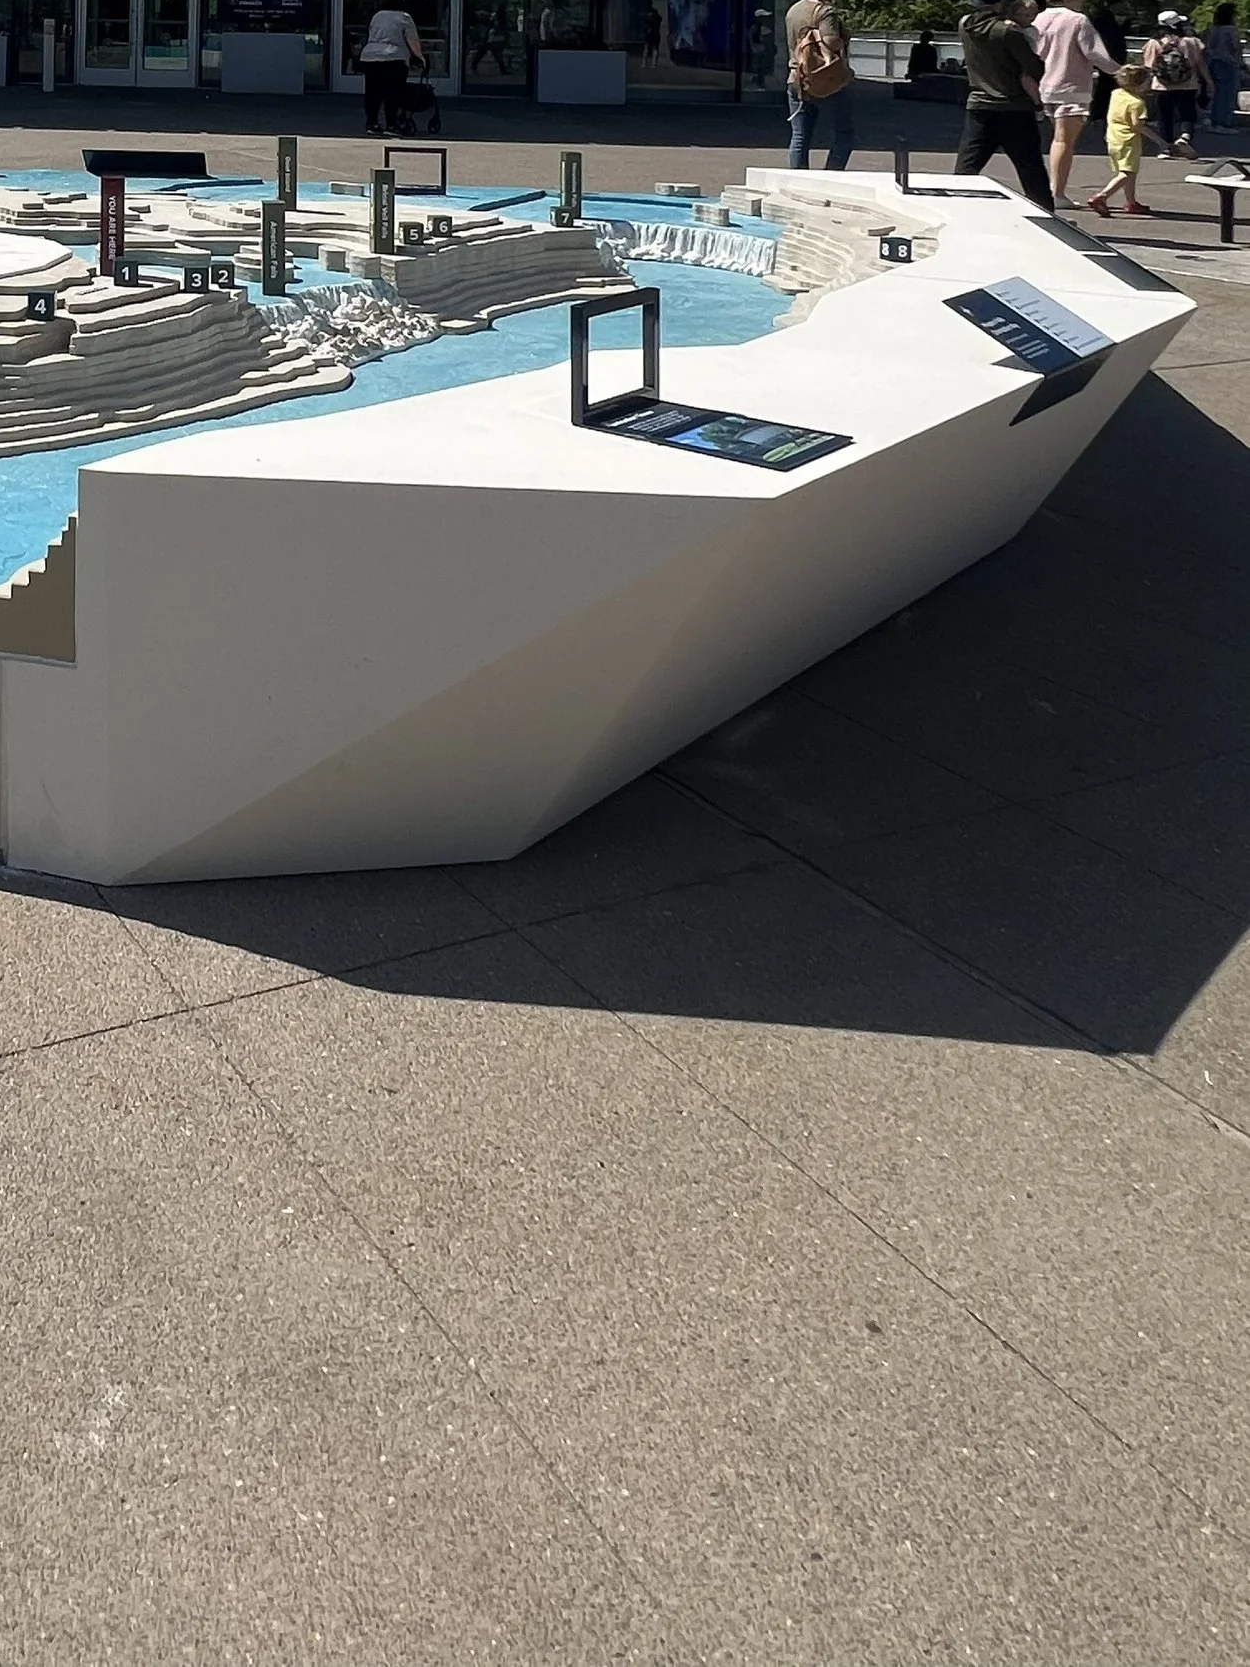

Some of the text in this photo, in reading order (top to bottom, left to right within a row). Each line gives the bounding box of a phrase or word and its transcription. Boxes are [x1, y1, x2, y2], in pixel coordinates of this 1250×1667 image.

[561, 212, 570, 224] 7
[107, 195, 117, 261] YOU ARE HERE
[439, 221, 448, 233] 6
[409, 228, 419, 241] 5
[269, 221, 278, 279] American Falls
[881, 242, 890, 256] 8
[898, 244, 908, 258] 8
[121, 266, 129, 281] 1
[191, 272, 202, 287] 3
[218, 269, 229, 283] 2
[34, 298, 47, 314] 4
